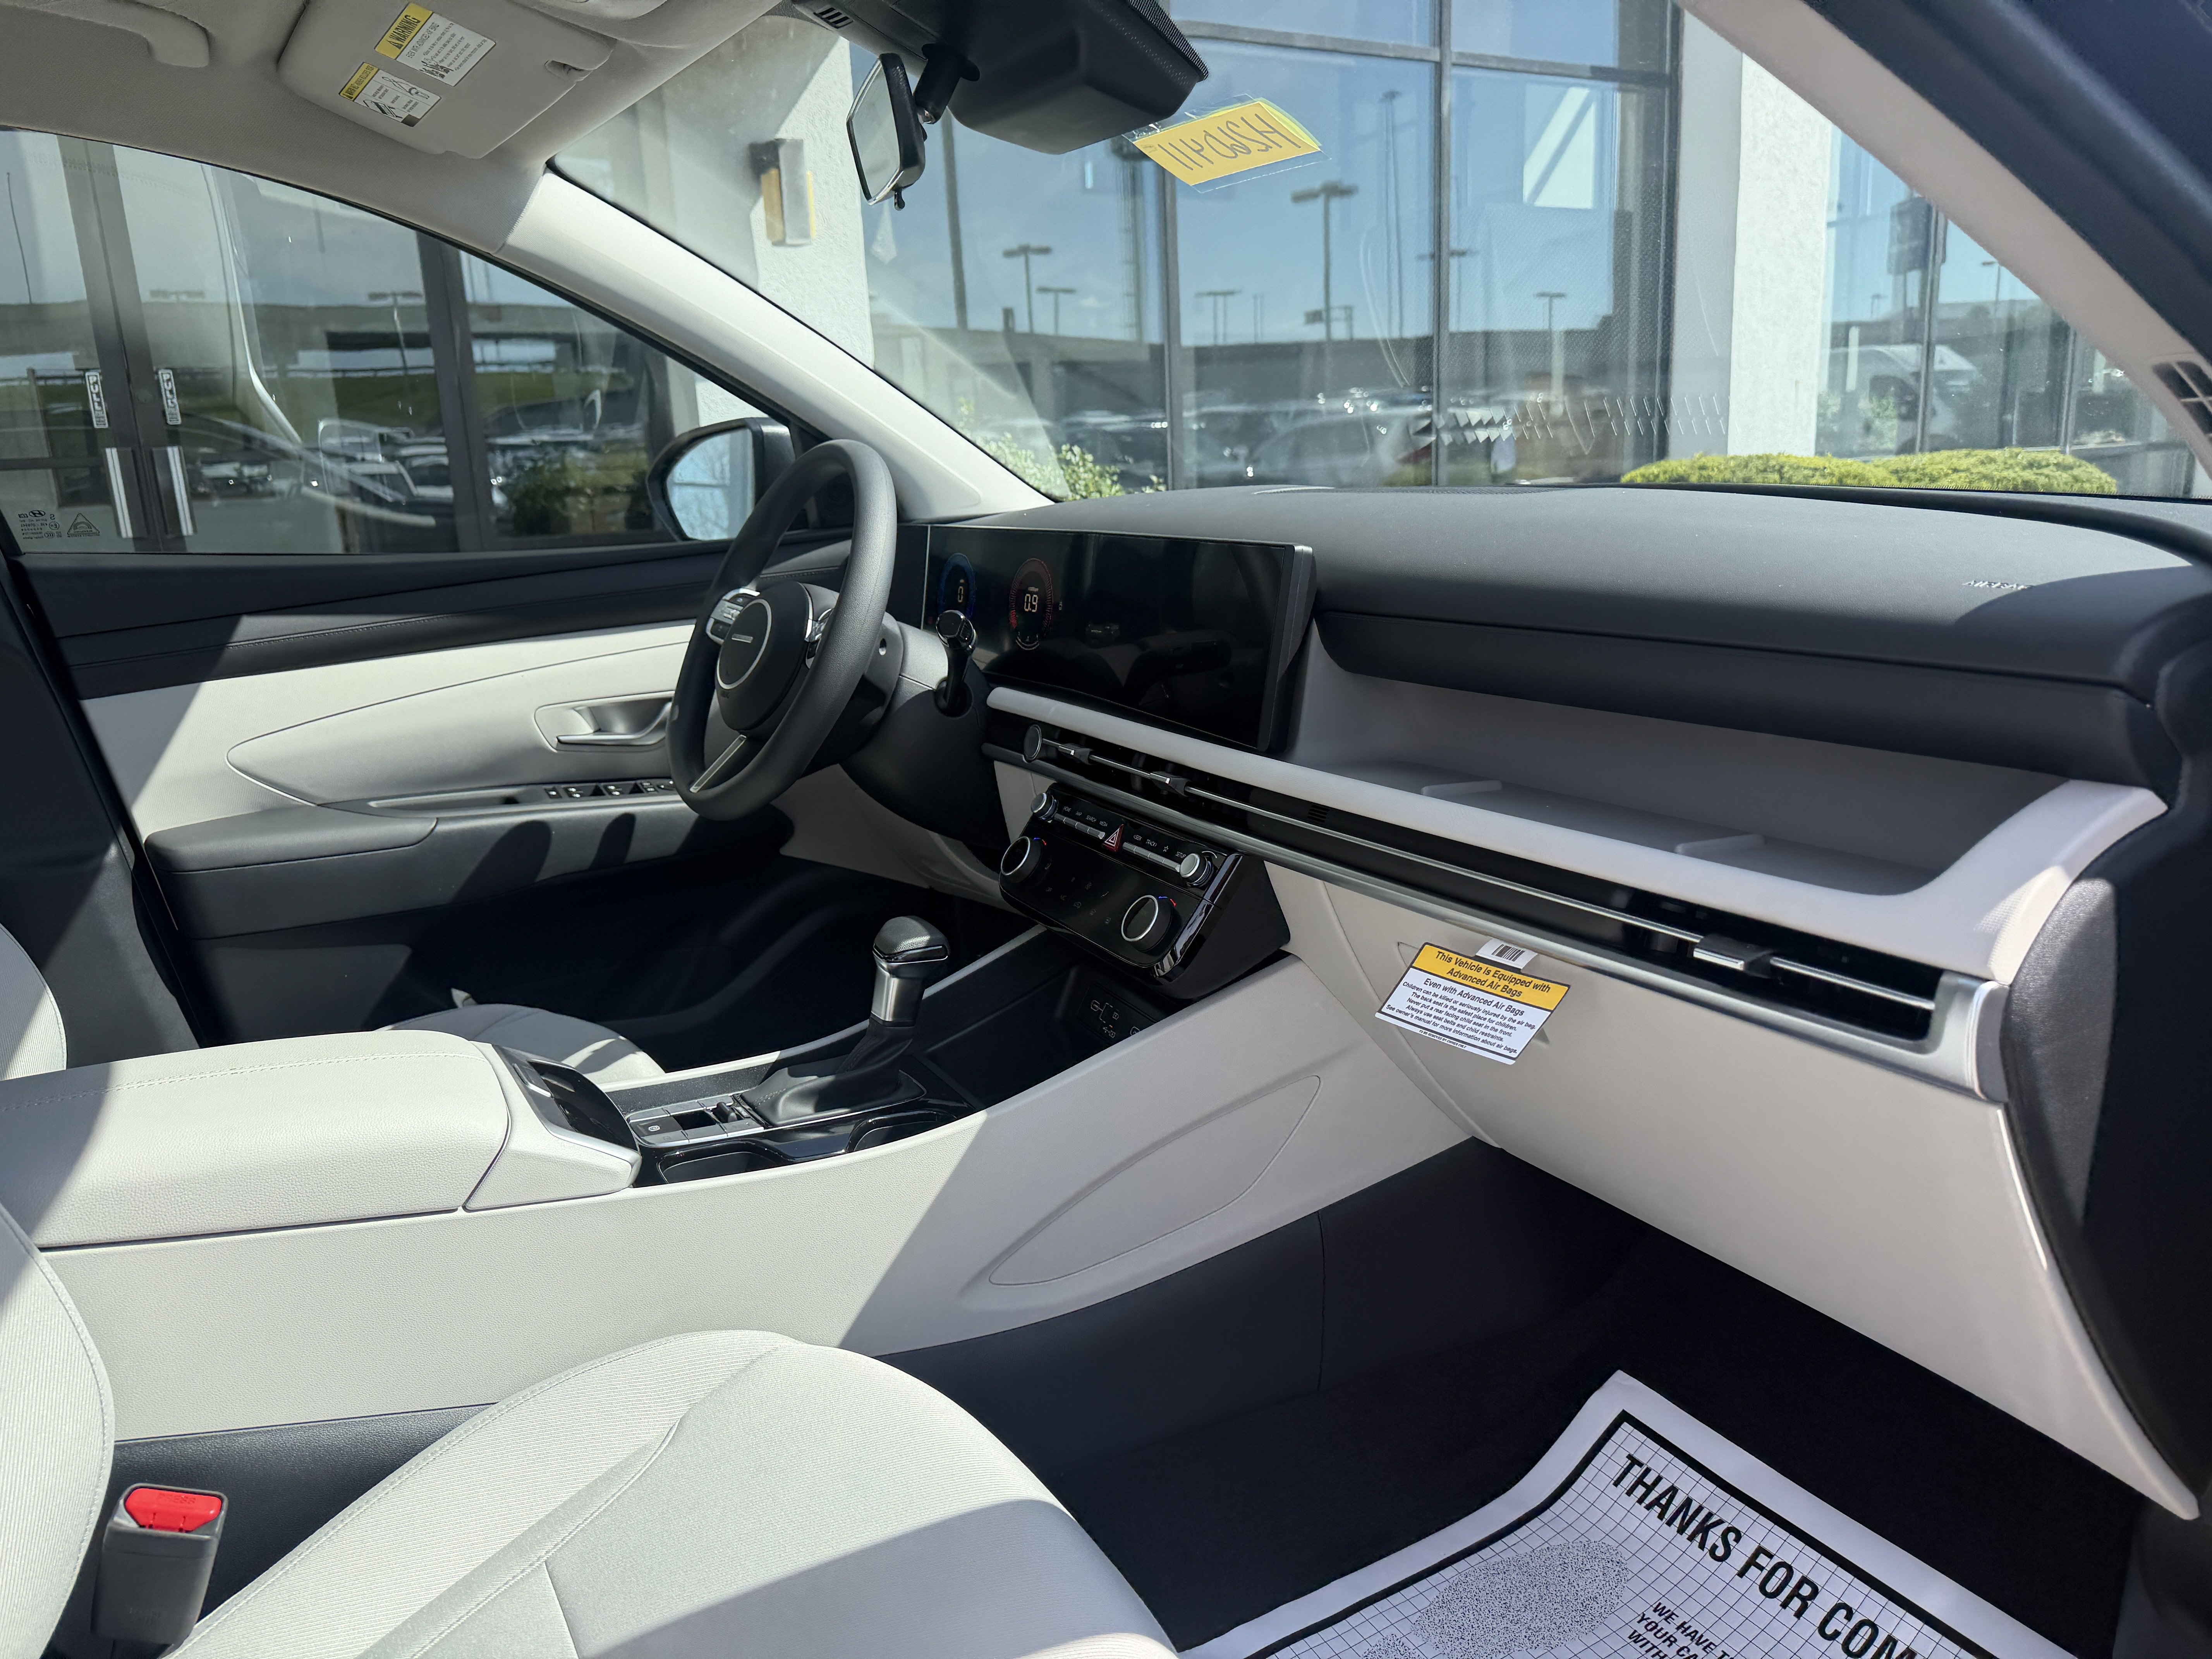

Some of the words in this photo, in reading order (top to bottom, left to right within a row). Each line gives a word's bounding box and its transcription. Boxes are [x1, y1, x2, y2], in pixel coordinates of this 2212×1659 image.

[389, 15, 421, 43] WARNING
[89, 376, 101, 410] PULL
[163, 373, 175, 407] PULL
[958, 586, 963, 603] 0
[1024, 594, 1038, 612] 0.9
[1436, 951, 1453, 963] This
[1455, 957, 1482, 973] Vehicle
[1492, 970, 1533, 988] Equipped
[1532, 983, 1551, 993] with
[1446, 968, 1489, 986] Advanced
[1486, 981, 1501, 990] Air
[1500, 984, 1522, 998] Bags
[1403, 981, 1423, 992] Children
[1438, 994, 1453, 1003] killed
[1458, 1002, 1482, 1013] seriously
[1482, 1008, 1501, 1018] injured
[1407, 997, 1422, 1006] Never
[1444, 1010, 1460, 1020] facing
[1424, 978, 1442, 989] Even
[1442, 986, 1457, 995] with
[1456, 990, 1494, 1006] Advanced
[1492, 1001, 1505, 1010] Air
[1504, 1005, 1525, 1016] Bags
[1457, 1009, 1474, 1017] safest
[1395, 1009, 1414, 1018] owner's
[1414, 1015, 1433, 1025] manual
[1452, 1028, 1481, 1042] information
[1480, 1039, 1496, 1047] about
[1405, 1005, 1423, 1014] Always
[1443, 1018, 1456, 1026] belts
[1613, 1454, 1742, 1563] THANKS
[1736, 1545, 1819, 1620] FOR
[1637, 1612, 1678, 1648] YOUR
[1652, 1602, 1679, 1625] WE
[1675, 1621, 1717, 1654] HAVE
